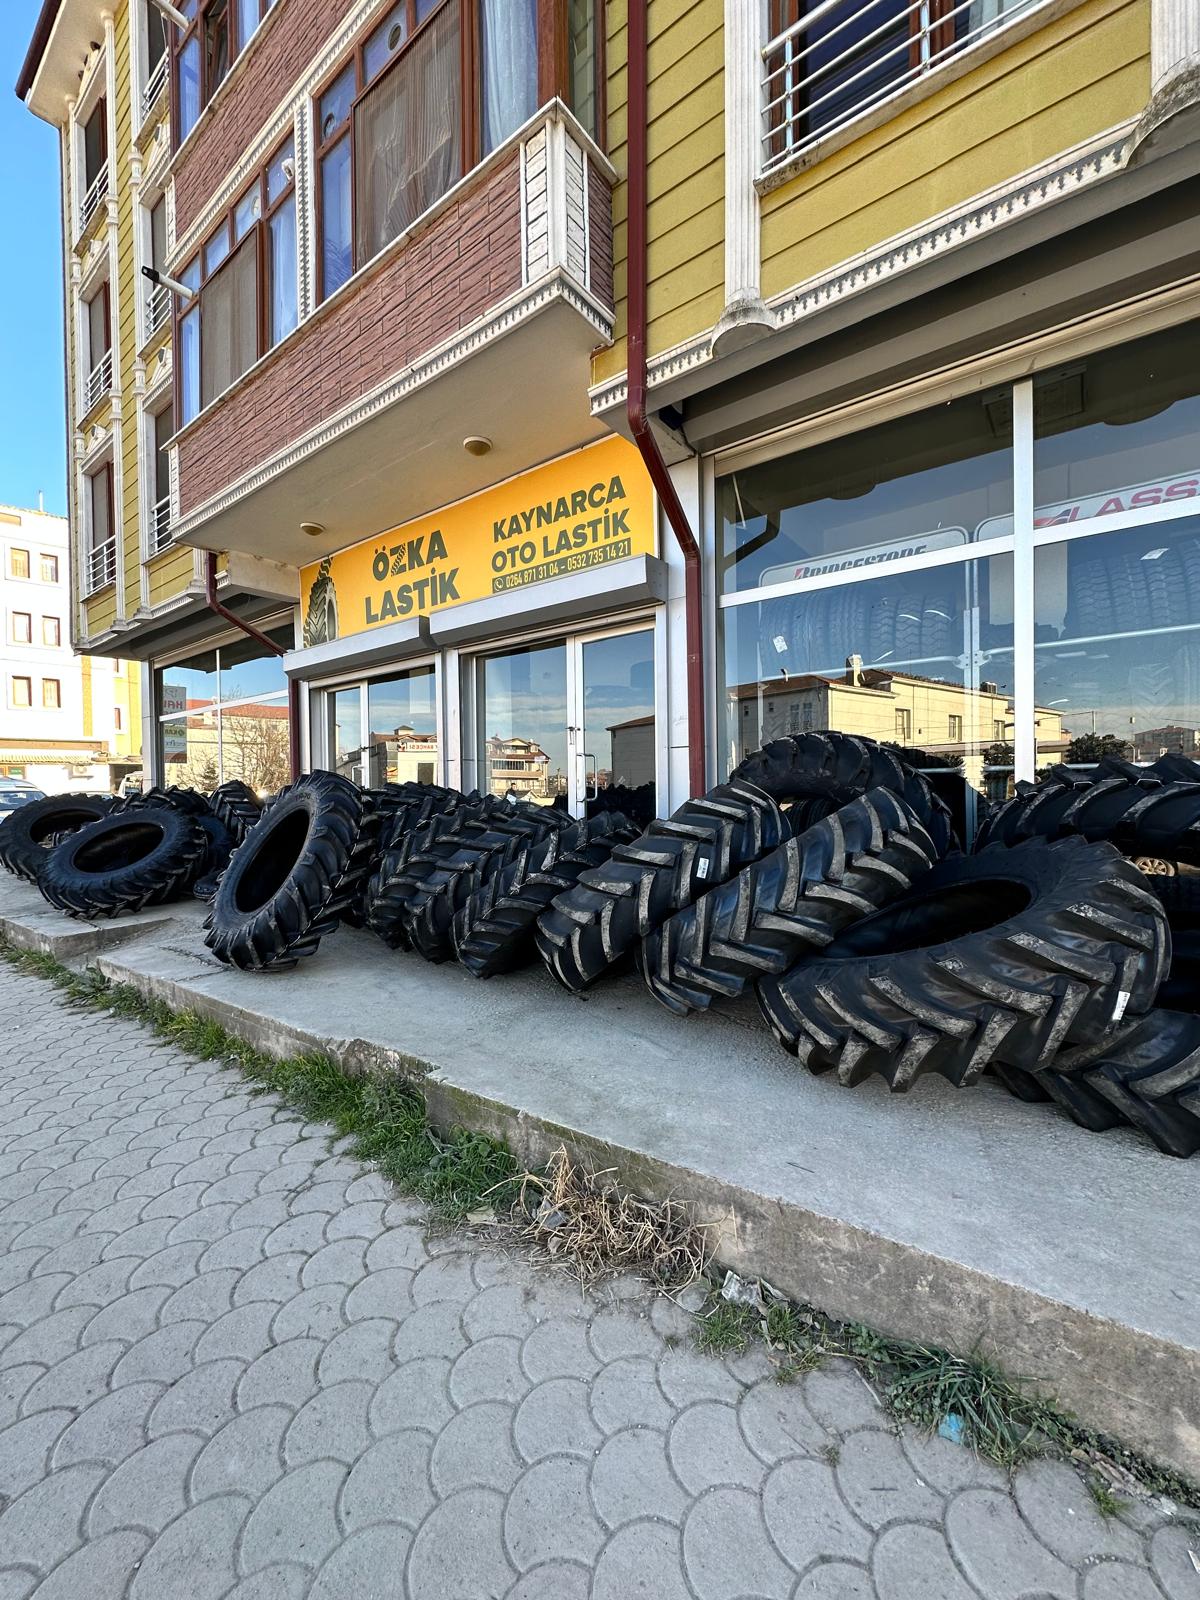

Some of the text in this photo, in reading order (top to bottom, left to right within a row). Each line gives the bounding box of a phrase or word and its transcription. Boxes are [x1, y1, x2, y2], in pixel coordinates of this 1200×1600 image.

[493, 475, 627, 543] KAYNARCA
[1068, 479, 1200, 522] LASS
[372, 529, 449, 582] ÖZKA
[491, 507, 631, 573] OTO LASTİK
[505, 573, 523, 588] 0264
[524, 567, 537, 580] 871
[538, 564, 548, 576] 31
[549, 561, 559, 576] 04
[567, 553, 587, 571] 0532
[588, 548, 604, 565] 735
[606, 546, 617, 560] 14
[618, 540, 630, 556] 21
[364, 567, 461, 625] LASTİK
